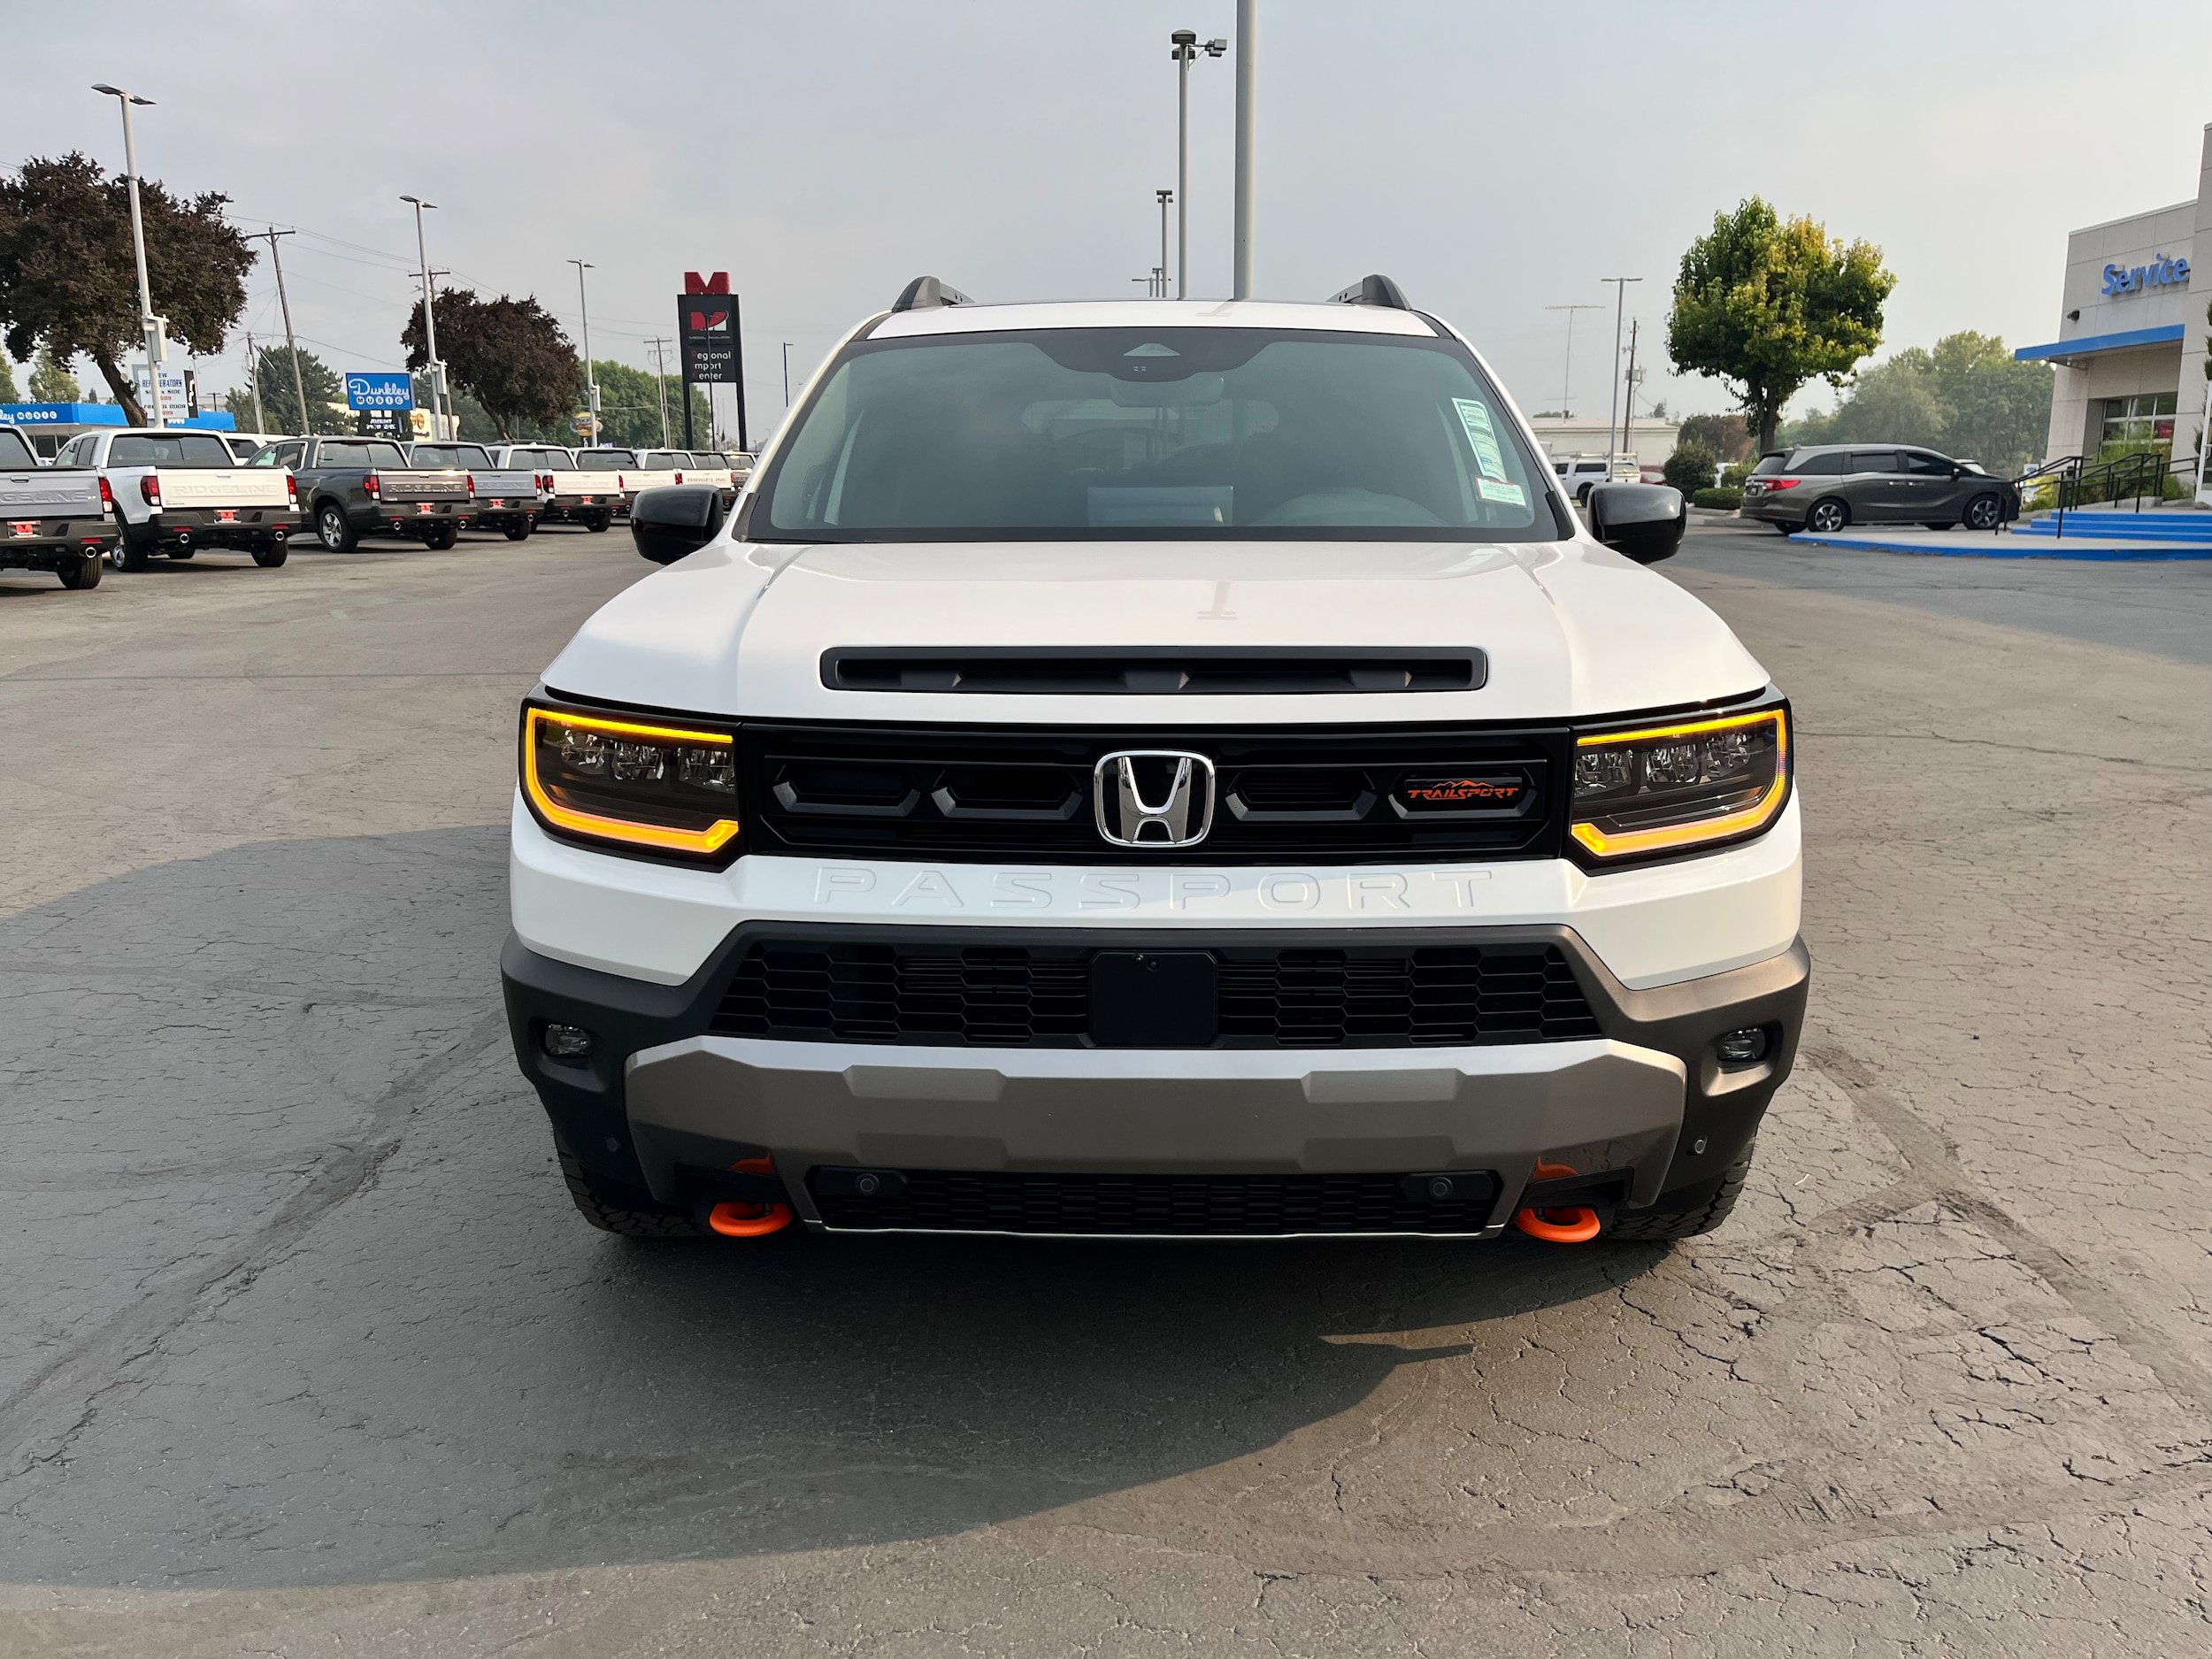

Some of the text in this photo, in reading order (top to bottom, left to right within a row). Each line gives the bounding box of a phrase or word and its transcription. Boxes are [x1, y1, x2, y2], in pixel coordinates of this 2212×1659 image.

[2101, 252, 2189, 296] Service
[692, 350, 732, 361] Regonal
[142, 379, 182, 388] REFERATORS
[349, 378, 410, 400] Dunkley
[175, 486, 278, 495] RIDGELINE
[1407, 787, 1519, 800] TRAILSPORT
[814, 866, 1493, 910] PASSPORT
